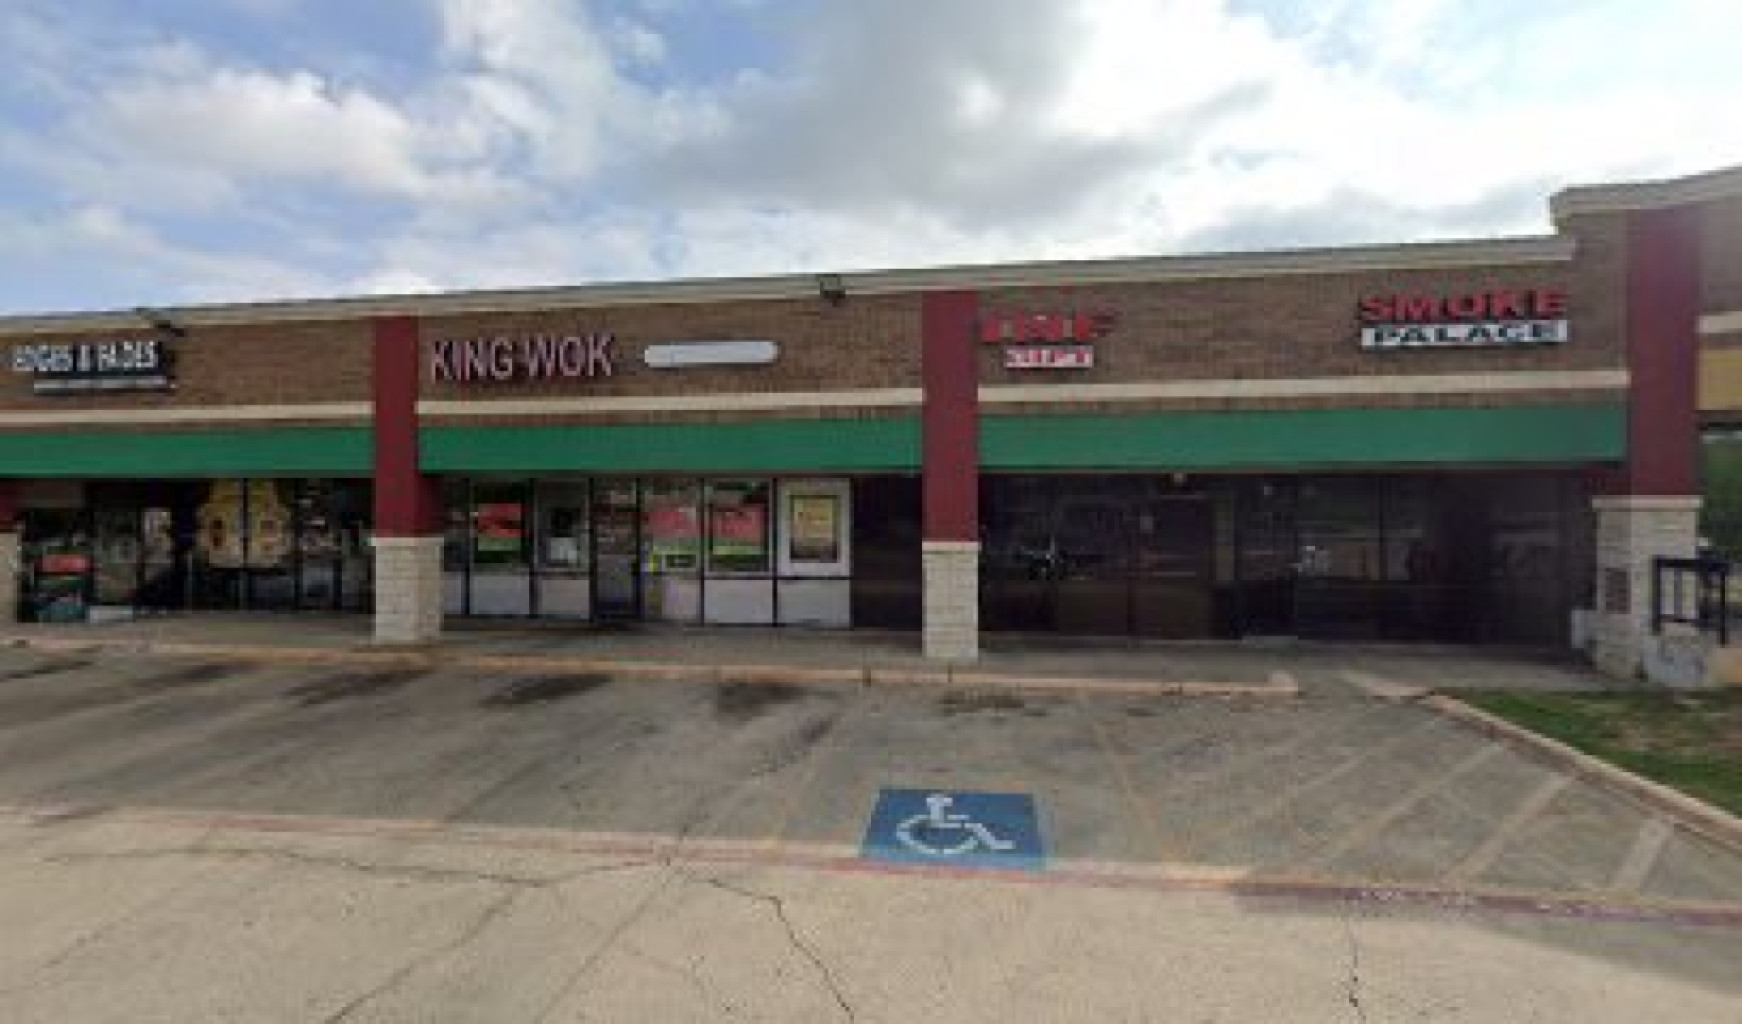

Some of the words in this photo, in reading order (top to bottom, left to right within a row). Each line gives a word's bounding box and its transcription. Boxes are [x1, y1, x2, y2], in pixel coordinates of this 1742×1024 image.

[1362, 289, 1568, 321] SMOKE
[1371, 323, 1562, 343] PALACE
[430, 337, 513, 382] KING
[526, 331, 614, 378] WOK
